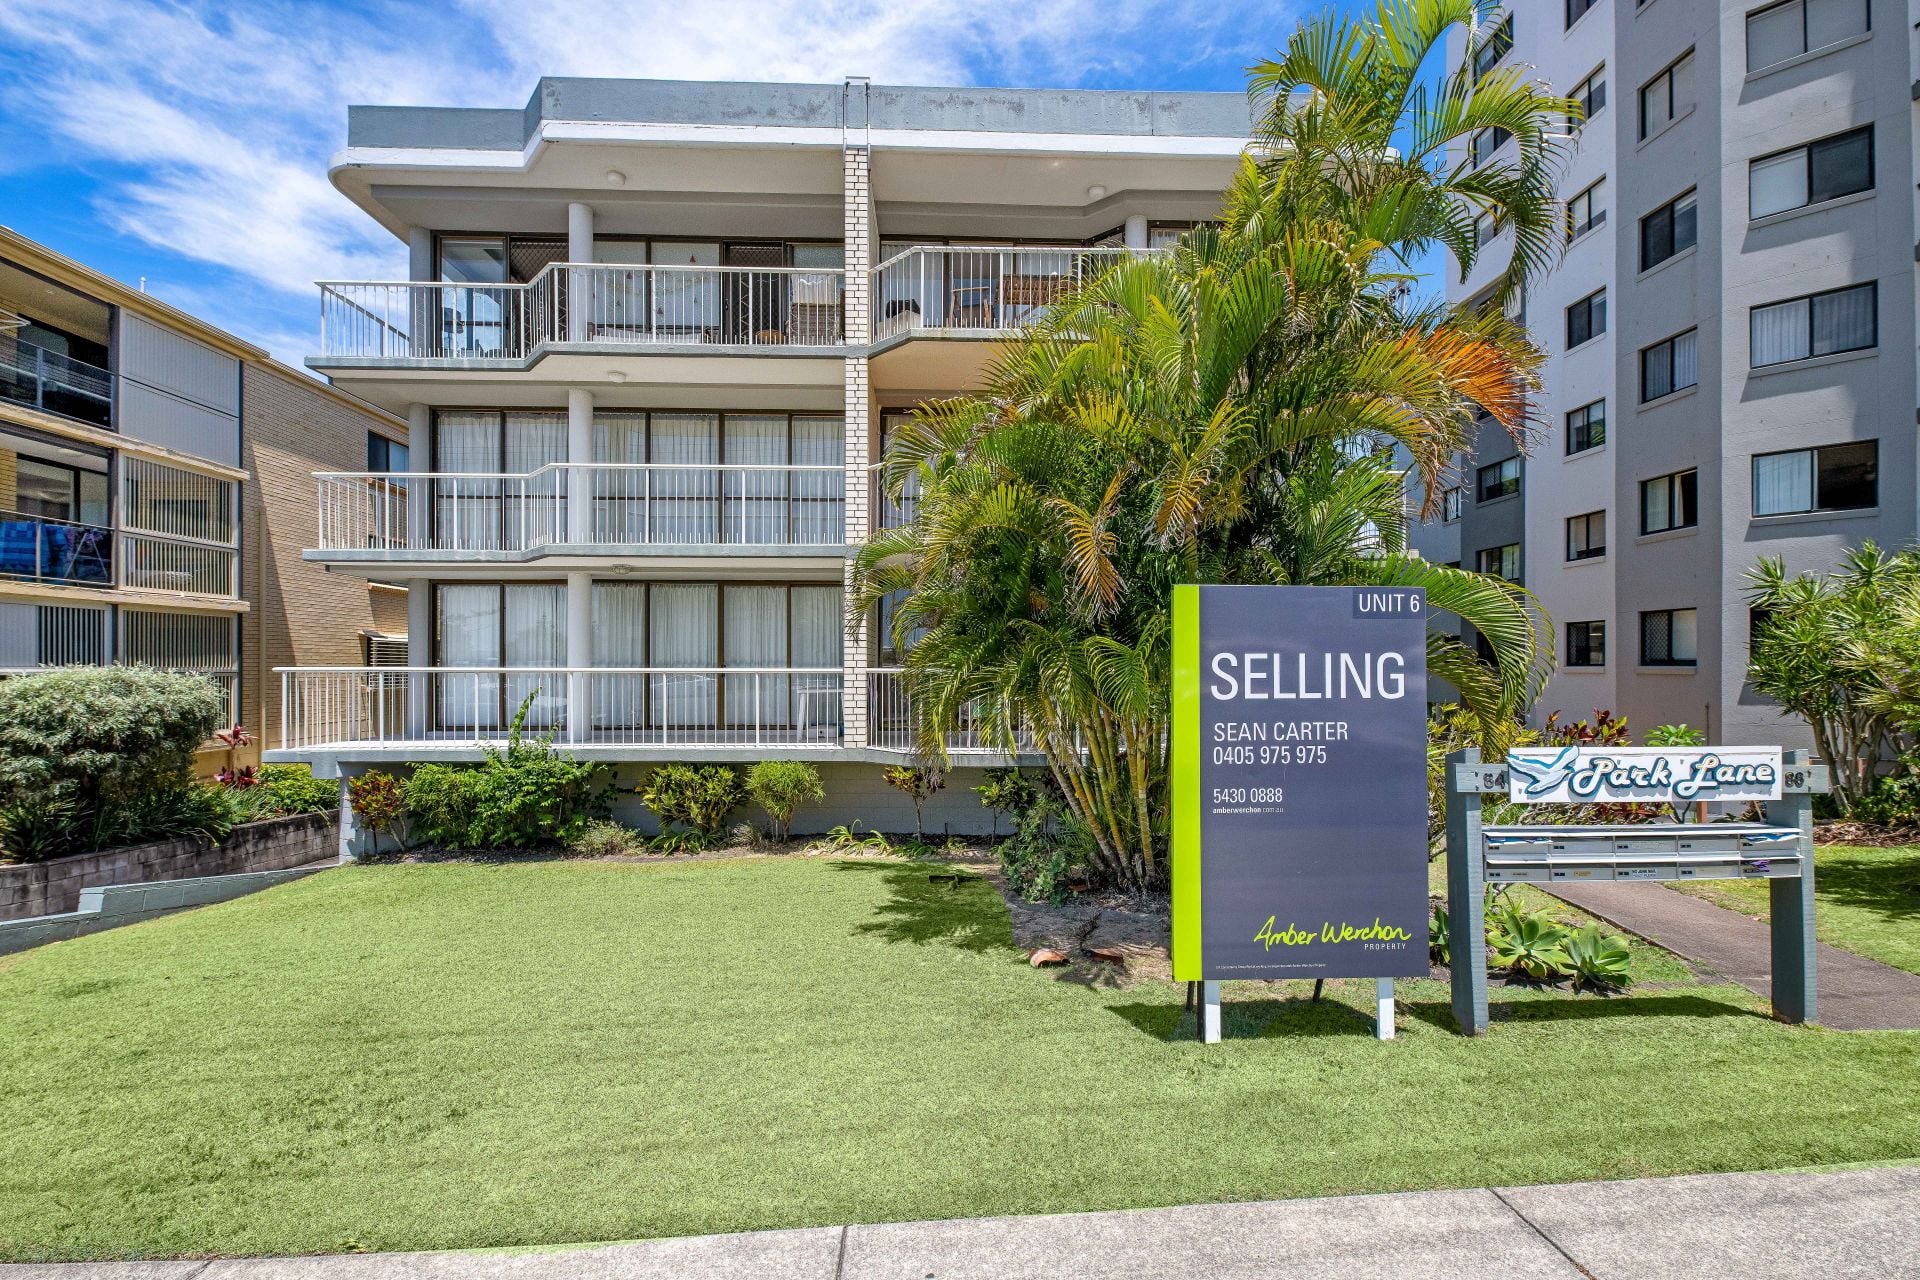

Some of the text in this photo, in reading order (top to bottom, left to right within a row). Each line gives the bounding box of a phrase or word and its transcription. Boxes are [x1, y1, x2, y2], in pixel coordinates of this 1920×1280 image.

[1359, 593, 1420, 613] UNIT 6
[1210, 652, 1405, 700] SELLING
[1213, 721, 1349, 742] SEAN CARTER
[1213, 746, 1327, 765] 0405 975 975
[1570, 753, 1776, 798] Park Lane
[1213, 787, 1283, 804] 5430 0888
[1253, 915, 1412, 952] Amber Werchon
[1364, 942, 1406, 951] PROPERTY
